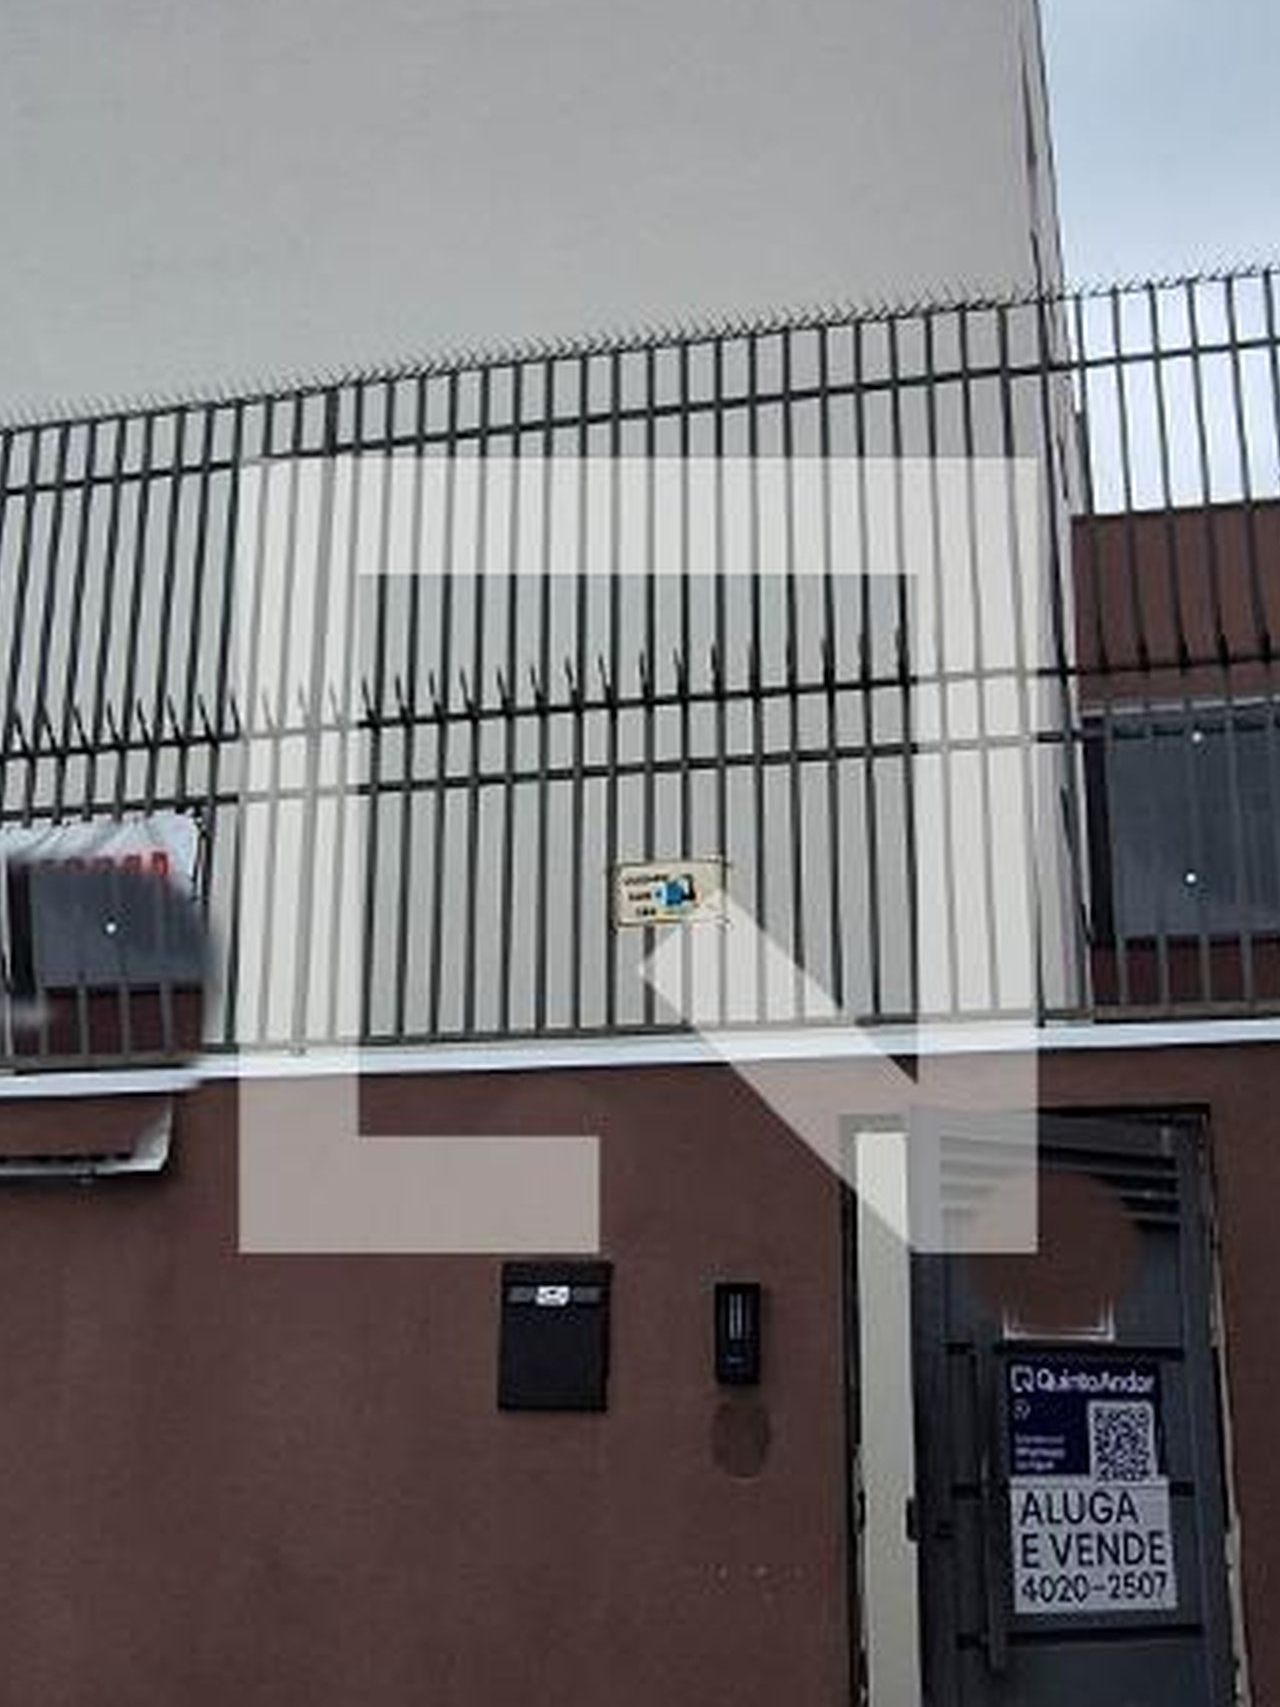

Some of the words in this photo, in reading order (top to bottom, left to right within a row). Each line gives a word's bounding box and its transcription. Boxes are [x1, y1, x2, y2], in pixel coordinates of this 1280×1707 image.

[1036, 1367, 1155, 1393] QuintoAndar
[1019, 1491, 1140, 1525] ALUGA
[1021, 1533, 1041, 1568] E
[1049, 1530, 1168, 1566] VENDE
[1020, 1571, 1169, 1603] 4020-2507
